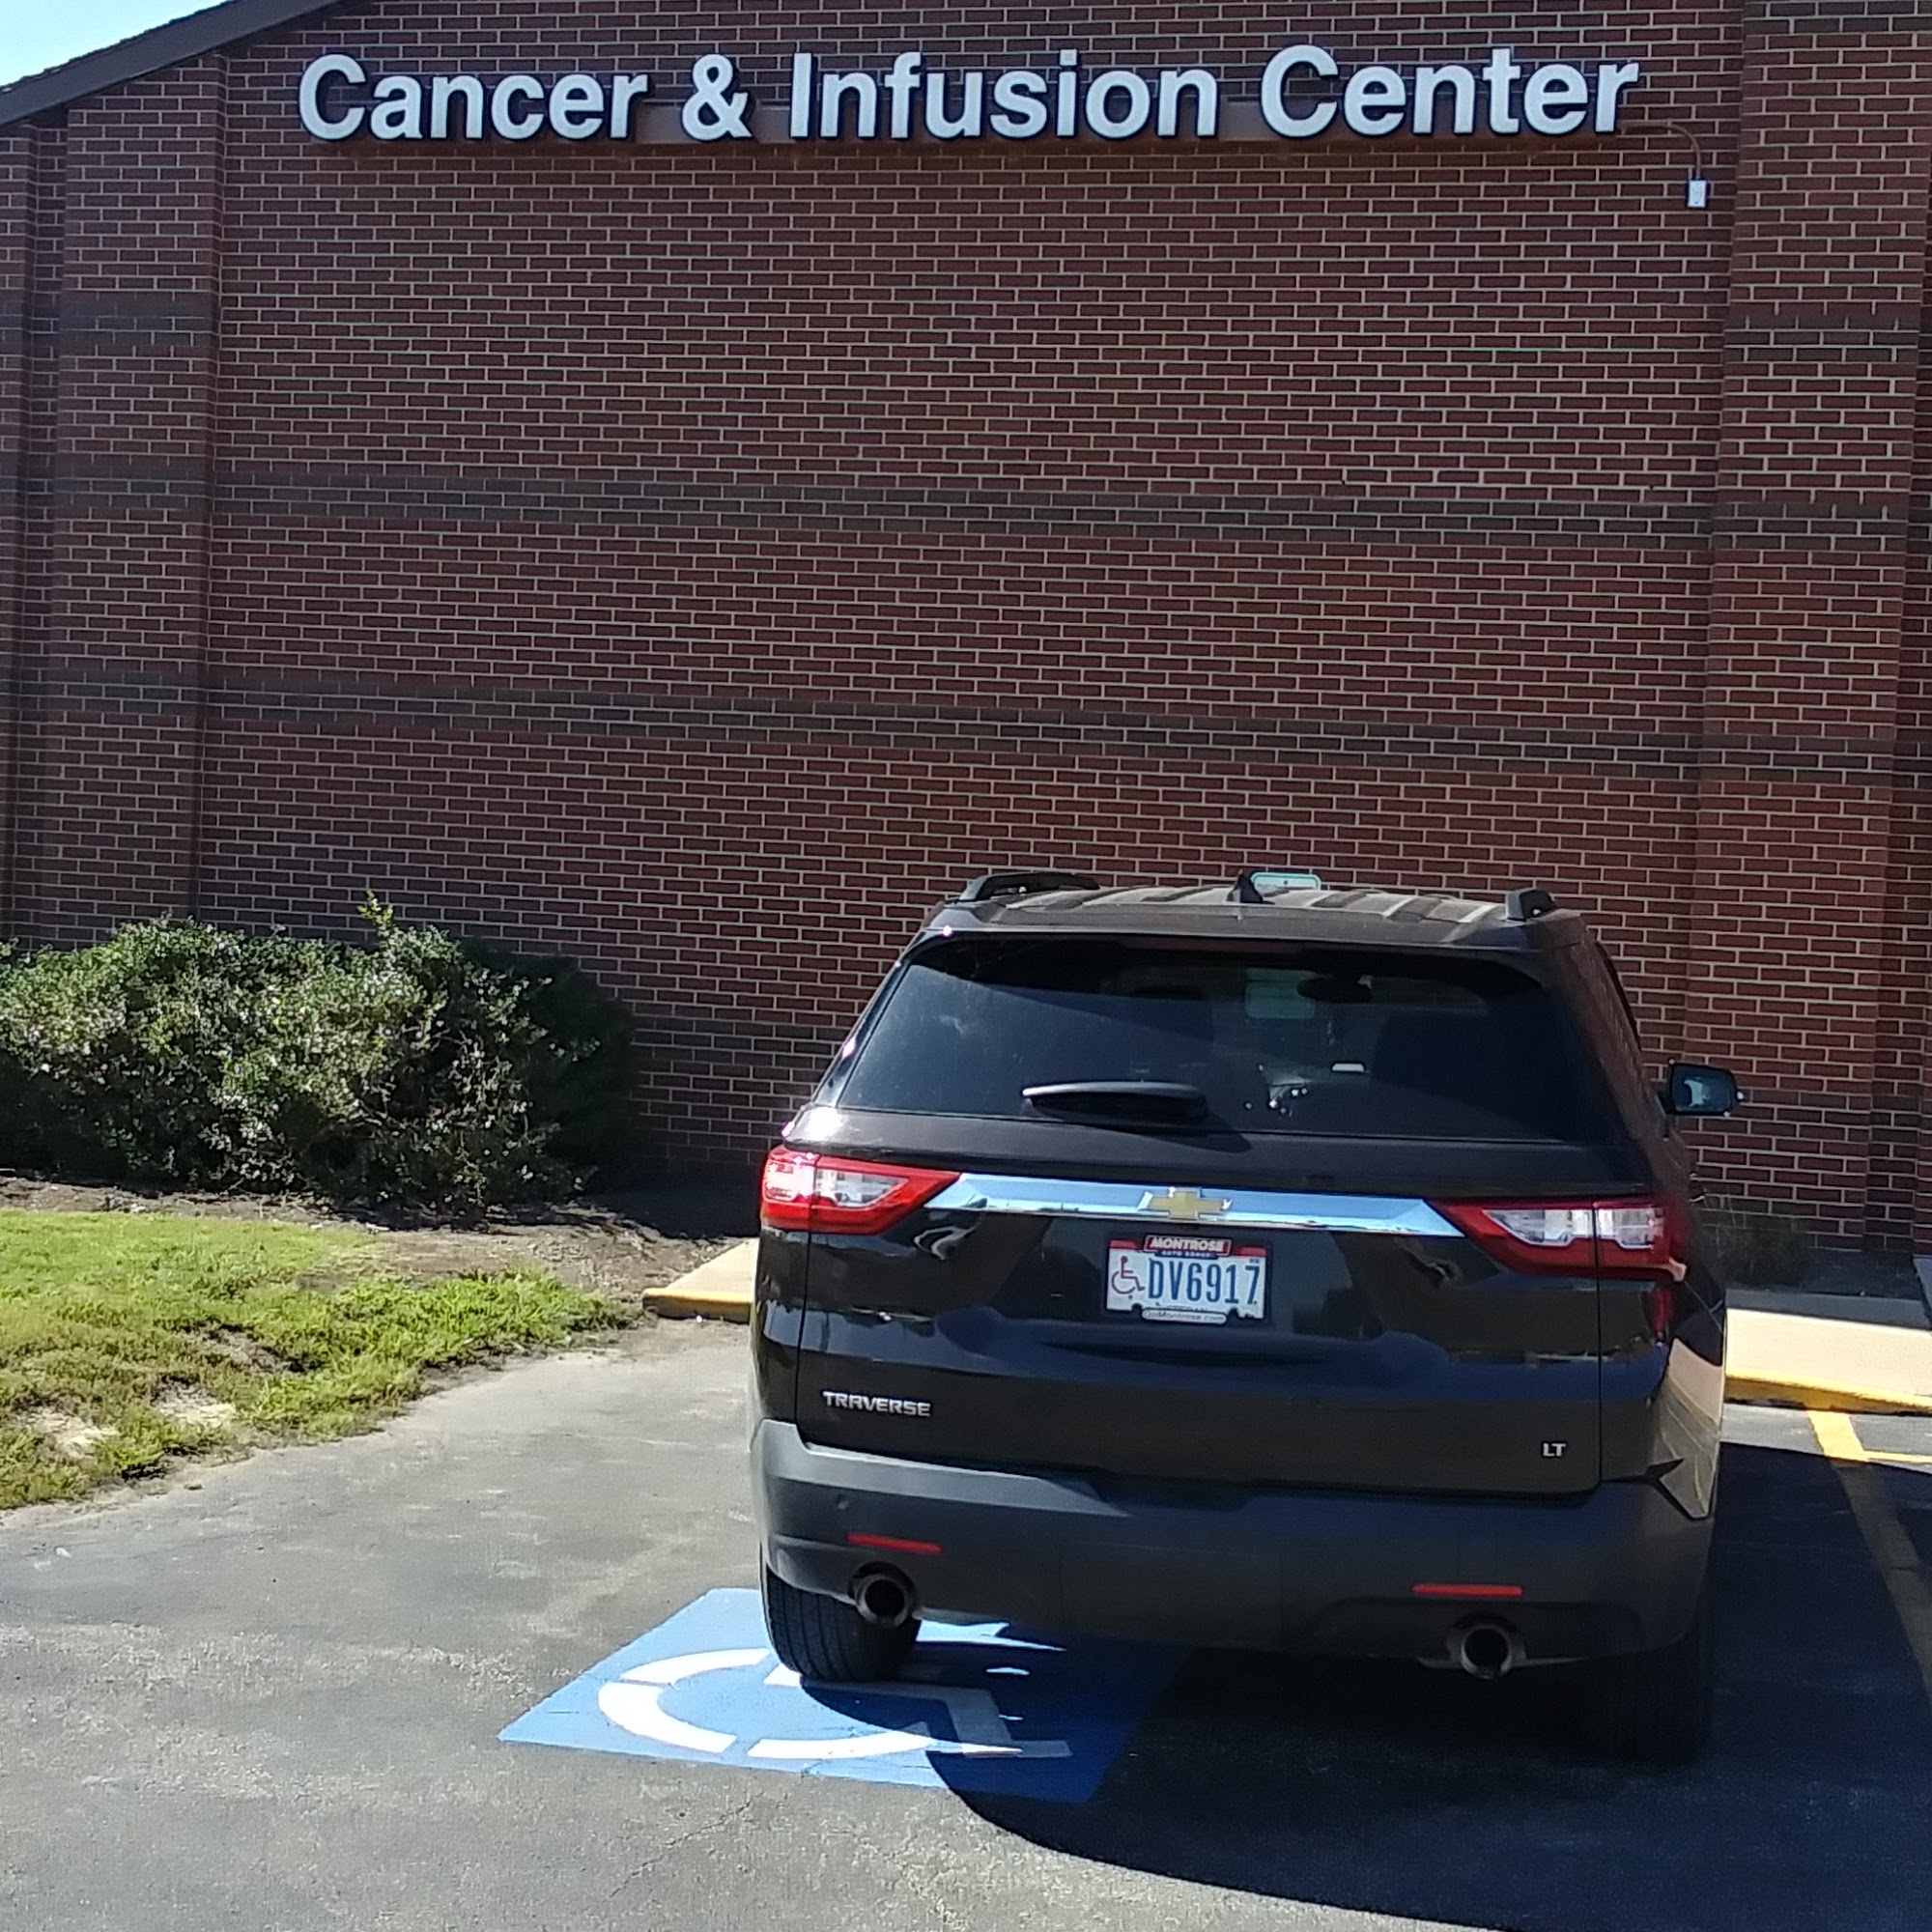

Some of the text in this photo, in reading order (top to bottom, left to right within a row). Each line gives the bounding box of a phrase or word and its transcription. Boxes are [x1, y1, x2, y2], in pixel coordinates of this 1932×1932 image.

[298, 43, 1640, 142] Cancer & Infusion Center
[1150, 1236, 1225, 1252] MONTROSE
[1148, 1257, 1261, 1305] DV6917
[822, 1390, 931, 1417] TRAVERSE
[1543, 1442, 1567, 1457] LT
